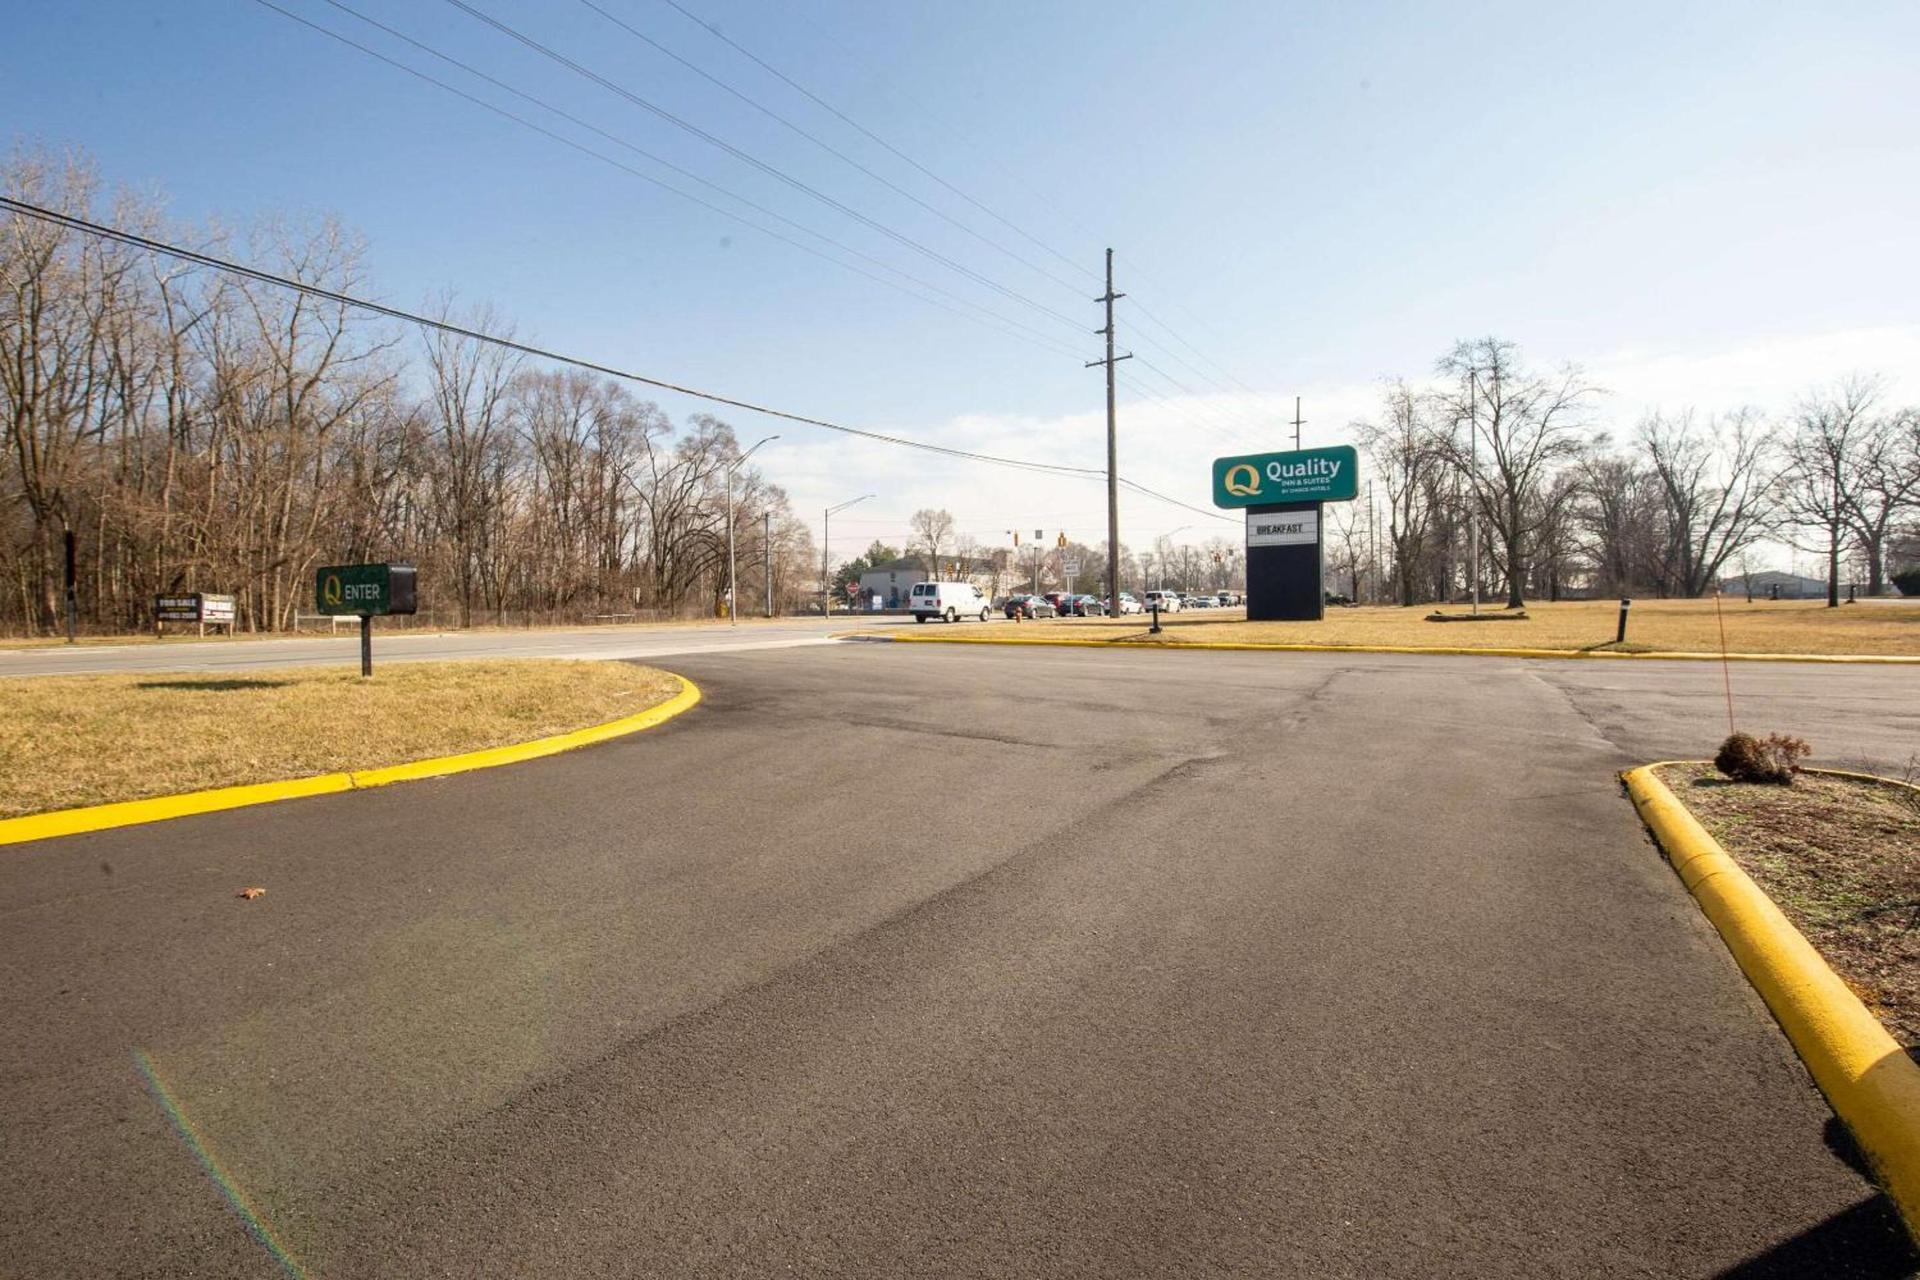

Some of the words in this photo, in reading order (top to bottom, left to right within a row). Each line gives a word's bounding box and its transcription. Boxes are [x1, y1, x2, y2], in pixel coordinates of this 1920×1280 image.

[1266, 458, 1341, 482] Quality
[1225, 464, 1262, 496] Q
[1303, 477, 1331, 485] SUITES
[1257, 523, 1303, 535] BREAKFAST
[325, 575, 342, 606] Q
[345, 585, 380, 600] ENTER
[177, 598, 197, 607] SALE
